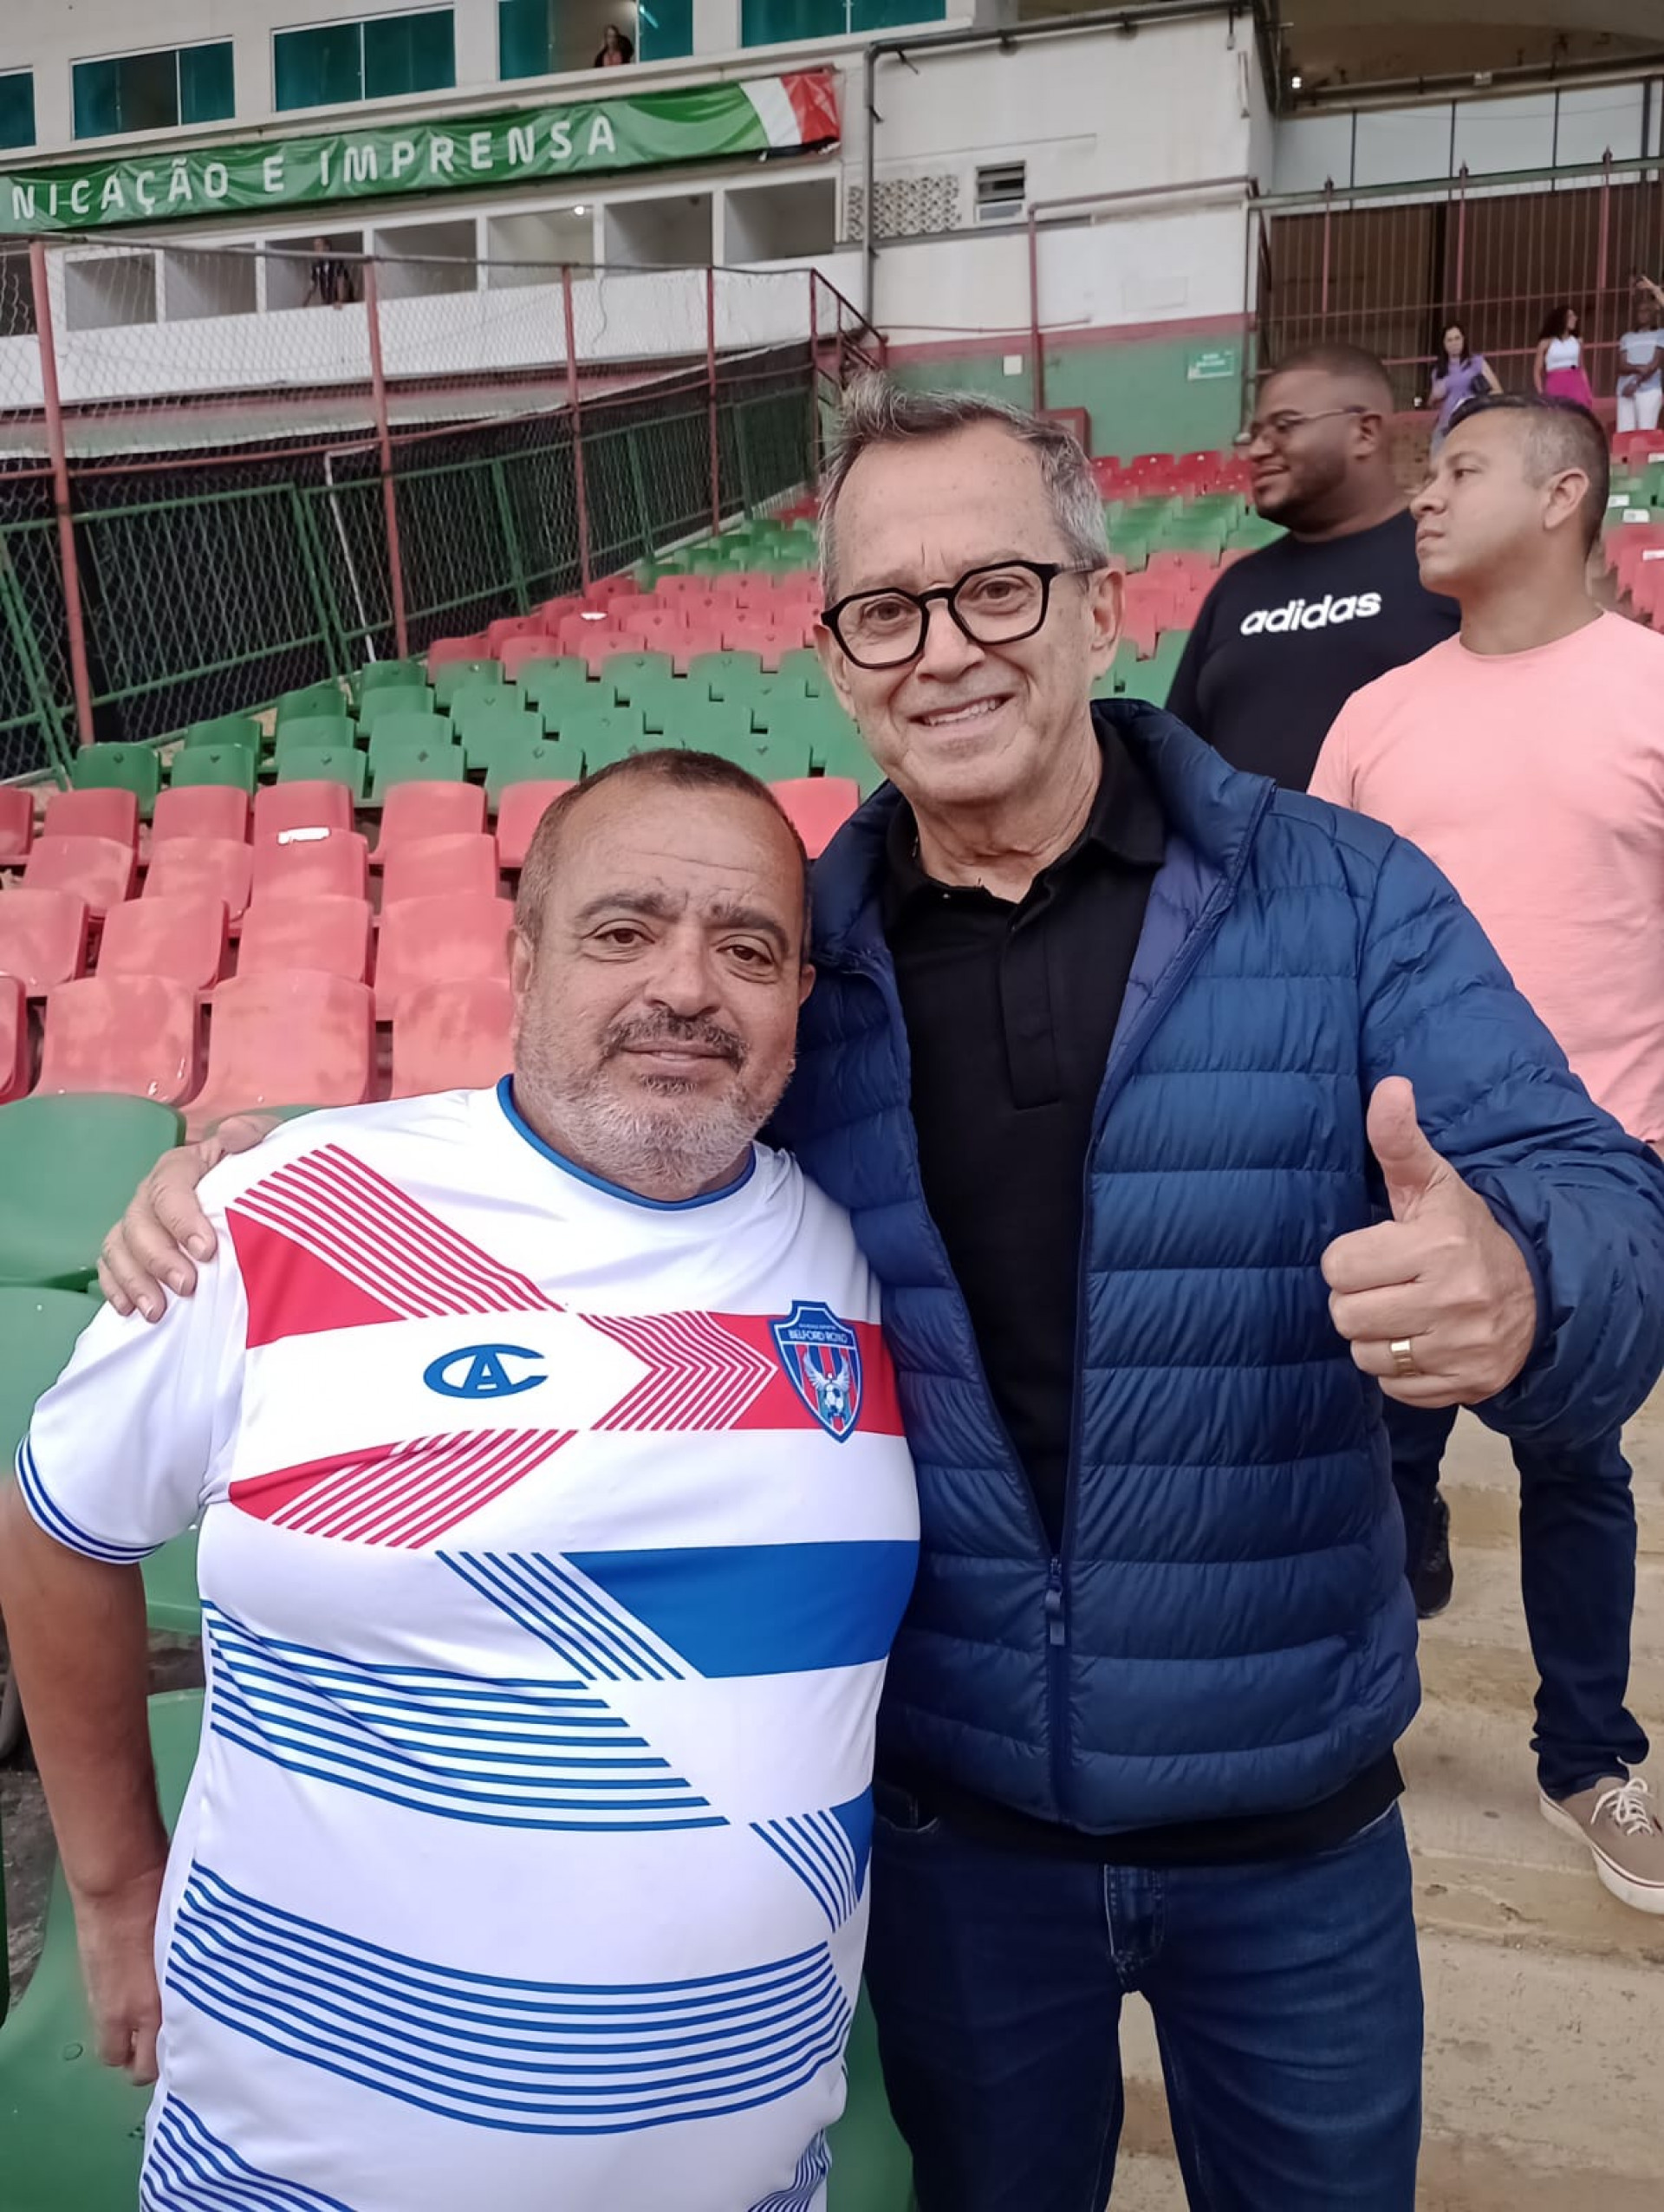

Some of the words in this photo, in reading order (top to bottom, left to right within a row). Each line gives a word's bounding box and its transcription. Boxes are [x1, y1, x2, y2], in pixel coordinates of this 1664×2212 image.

[11, 158, 228, 220] NICAÇÃO
[263, 154, 285, 192] E
[320, 115, 616, 185] IMPRENSA
[1240, 592, 1381, 635] adidas
